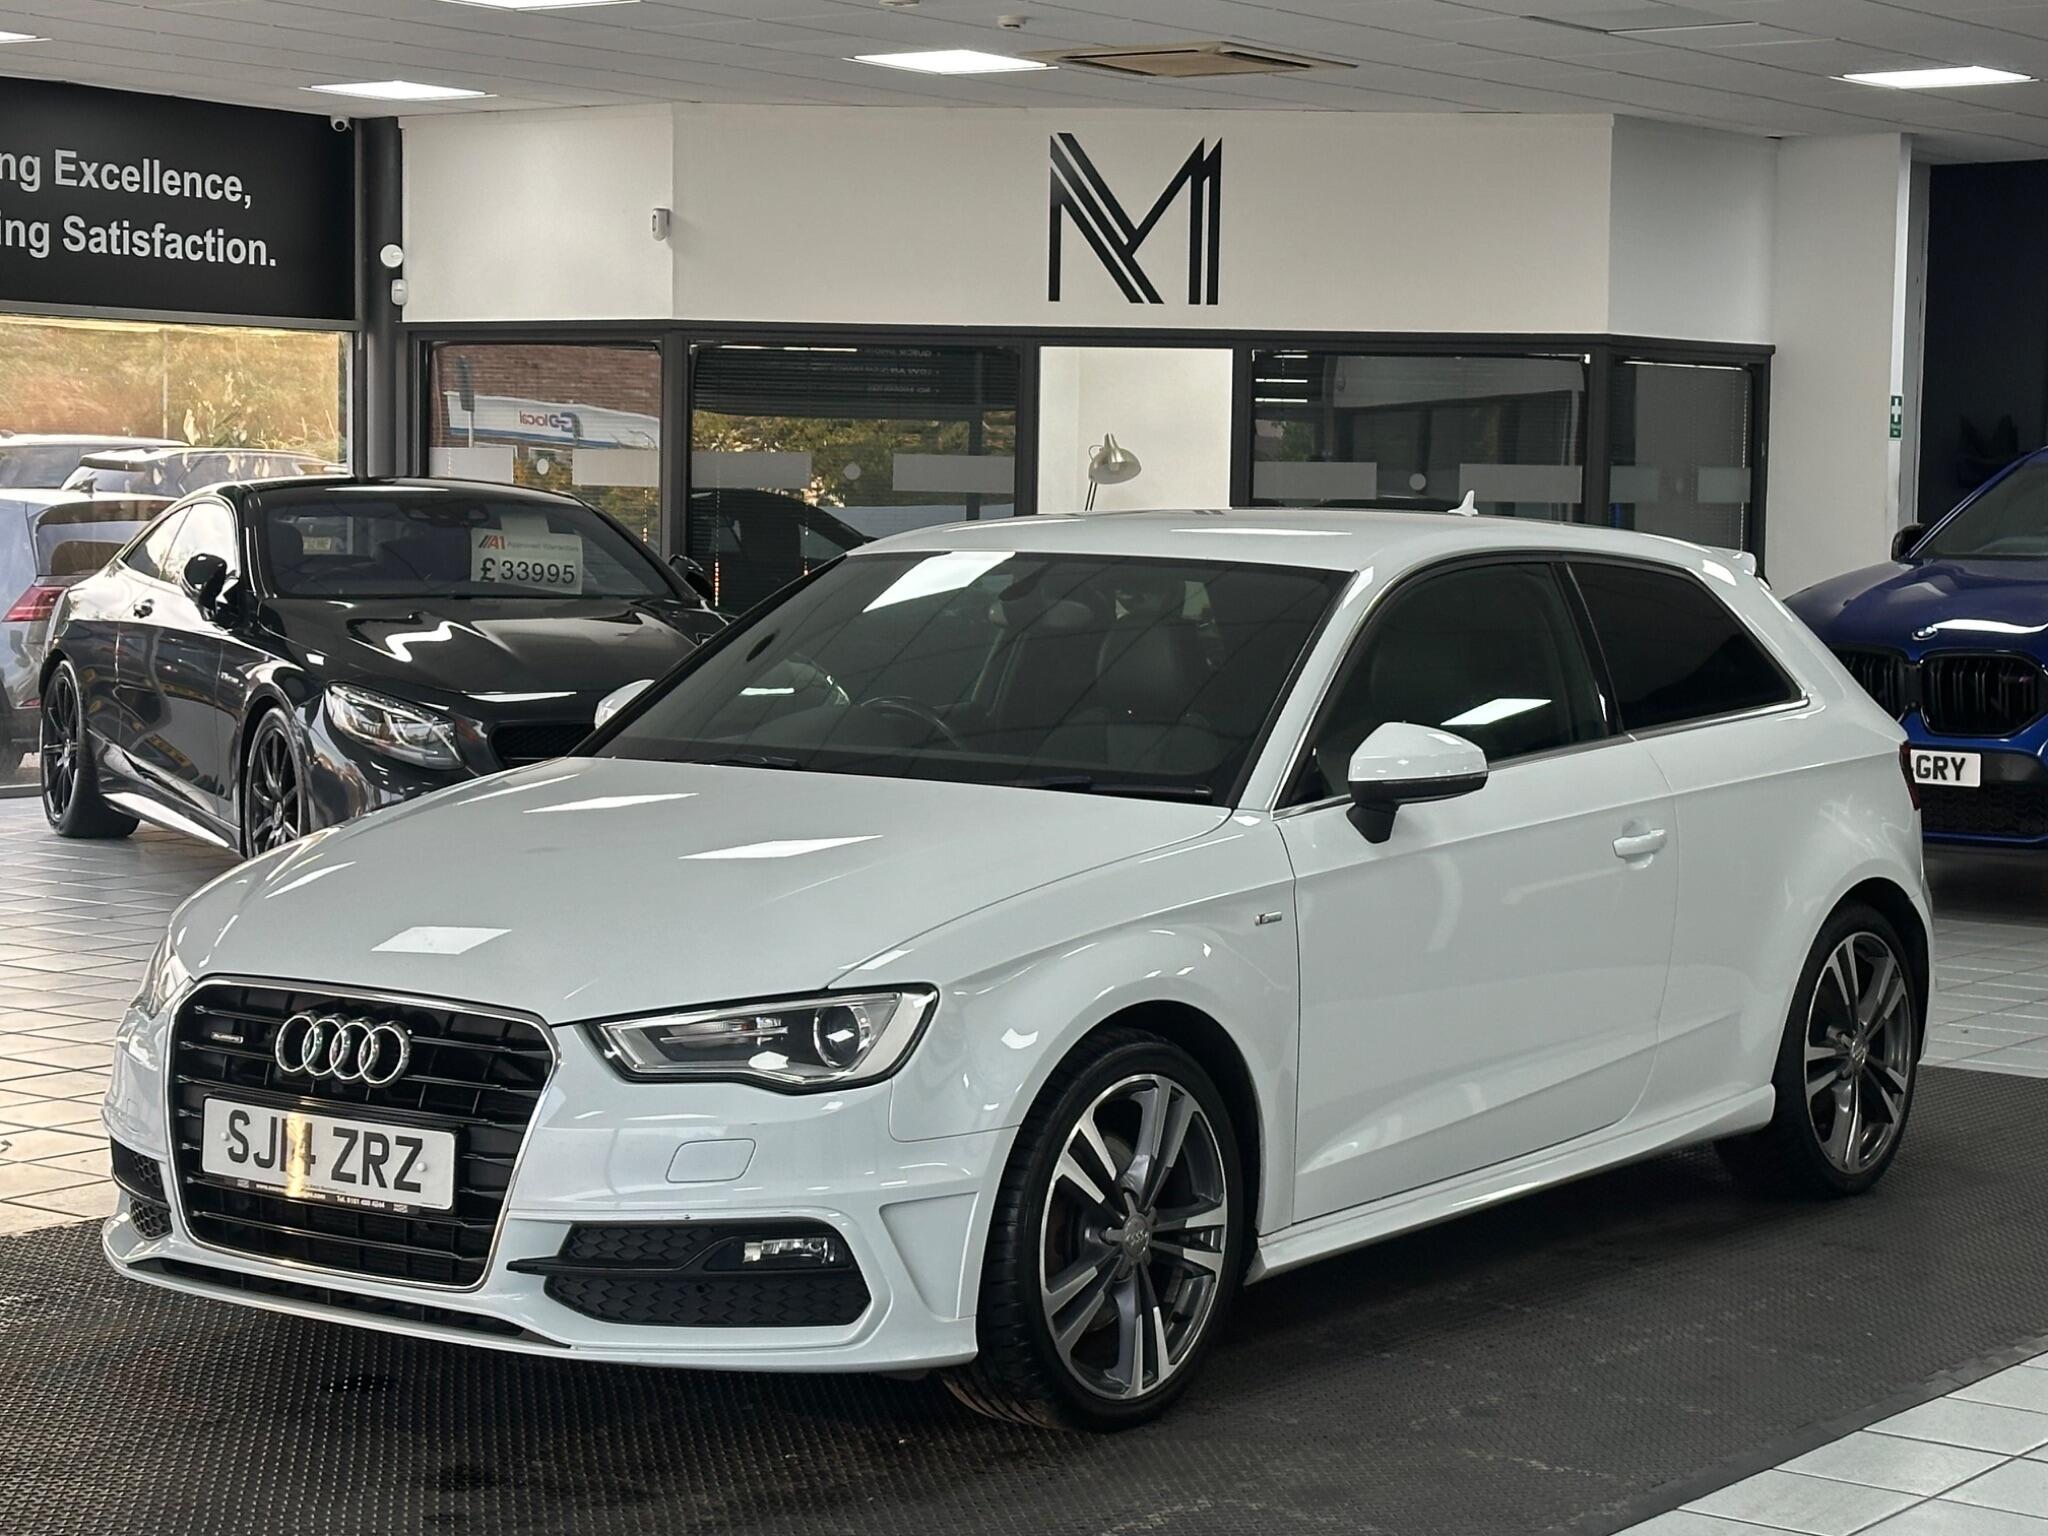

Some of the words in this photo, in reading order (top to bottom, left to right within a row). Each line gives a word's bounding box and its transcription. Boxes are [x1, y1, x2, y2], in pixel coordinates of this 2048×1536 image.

[54, 149, 252, 209] Excellence,
[0, 213, 50, 259] ng
[62, 215, 277, 267] Satisfaction.
[1915, 754, 1966, 781] GRY
[330, 1126, 423, 1193] ZRZ
